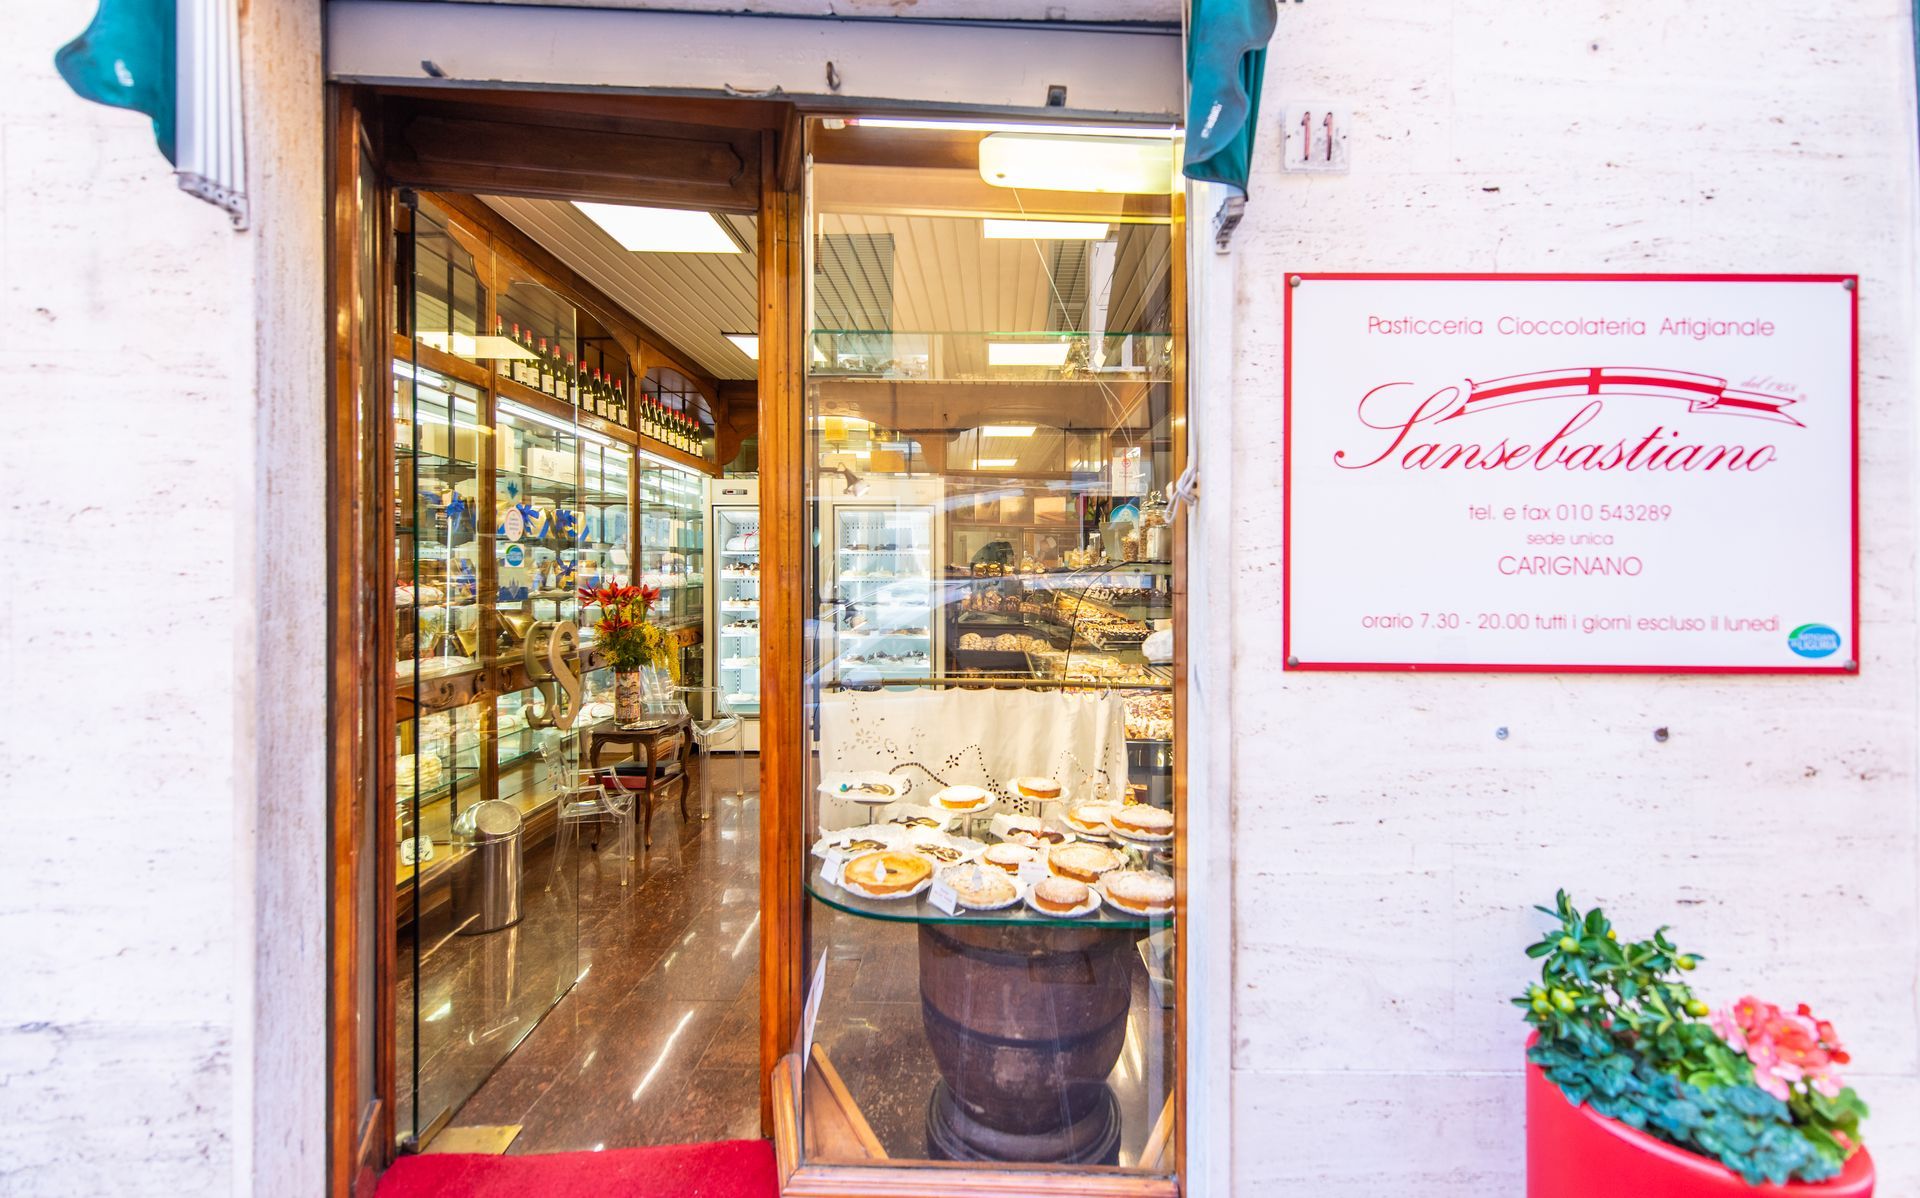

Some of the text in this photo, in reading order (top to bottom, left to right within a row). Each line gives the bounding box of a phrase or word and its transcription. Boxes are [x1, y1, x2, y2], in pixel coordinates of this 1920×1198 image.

[1301, 111, 1333, 161] 11
[1367, 315, 1776, 341] Pasticceria Cioccolateria Artigianale
[1334, 381, 1776, 471] Sansebastiano
[1469, 504, 1673, 522] tel. e fax 010 543289
[1527, 533, 1614, 546] sede unica
[1498, 555, 1644, 577] CARIGNANO
[1361, 613, 1414, 630] orario
[1420, 613, 1460, 630] 7.30
[1477, 613, 1530, 630] 20.00
[1535, 614, 1567, 631] tutti
[1581, 614, 1632, 635] giorni
[1636, 615, 1706, 632] escluso
[1711, 615, 1720, 632] il
